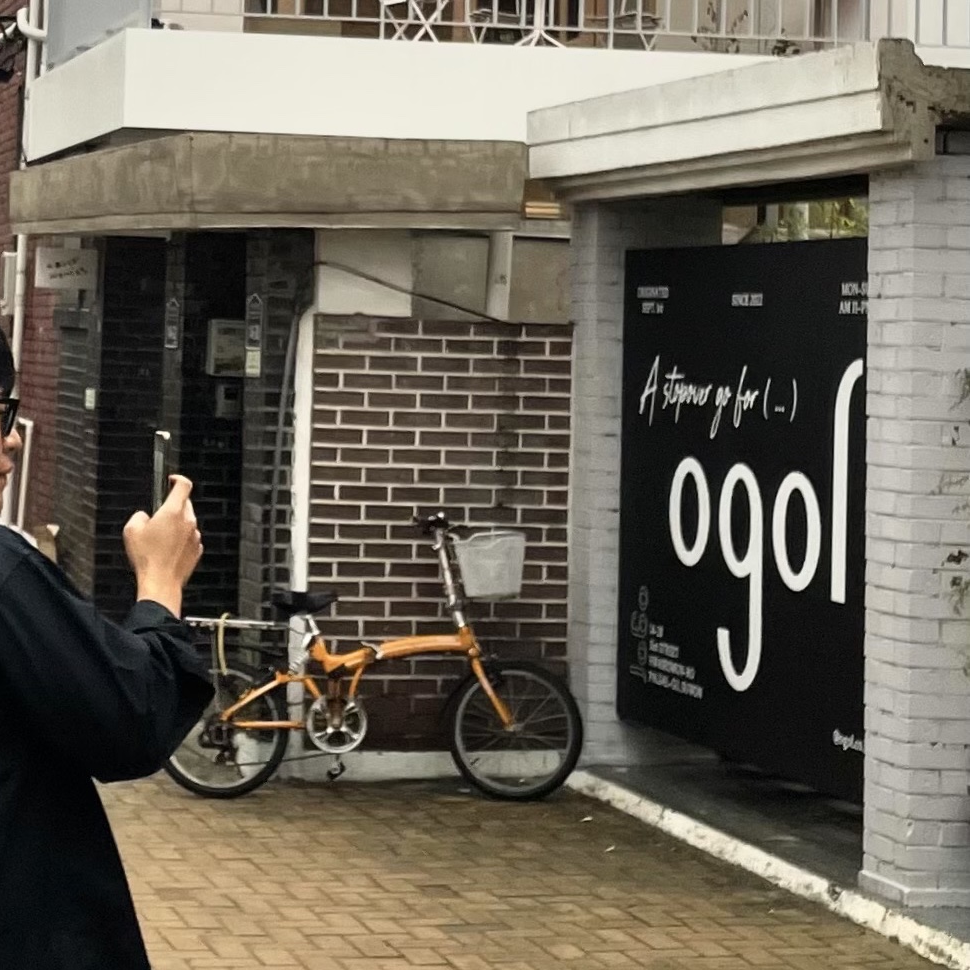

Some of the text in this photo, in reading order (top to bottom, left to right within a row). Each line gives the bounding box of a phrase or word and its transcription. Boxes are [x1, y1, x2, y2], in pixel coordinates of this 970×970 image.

[638, 354, 660, 427] A
[709, 386, 732, 440] go
[733, 364, 759, 429] for
